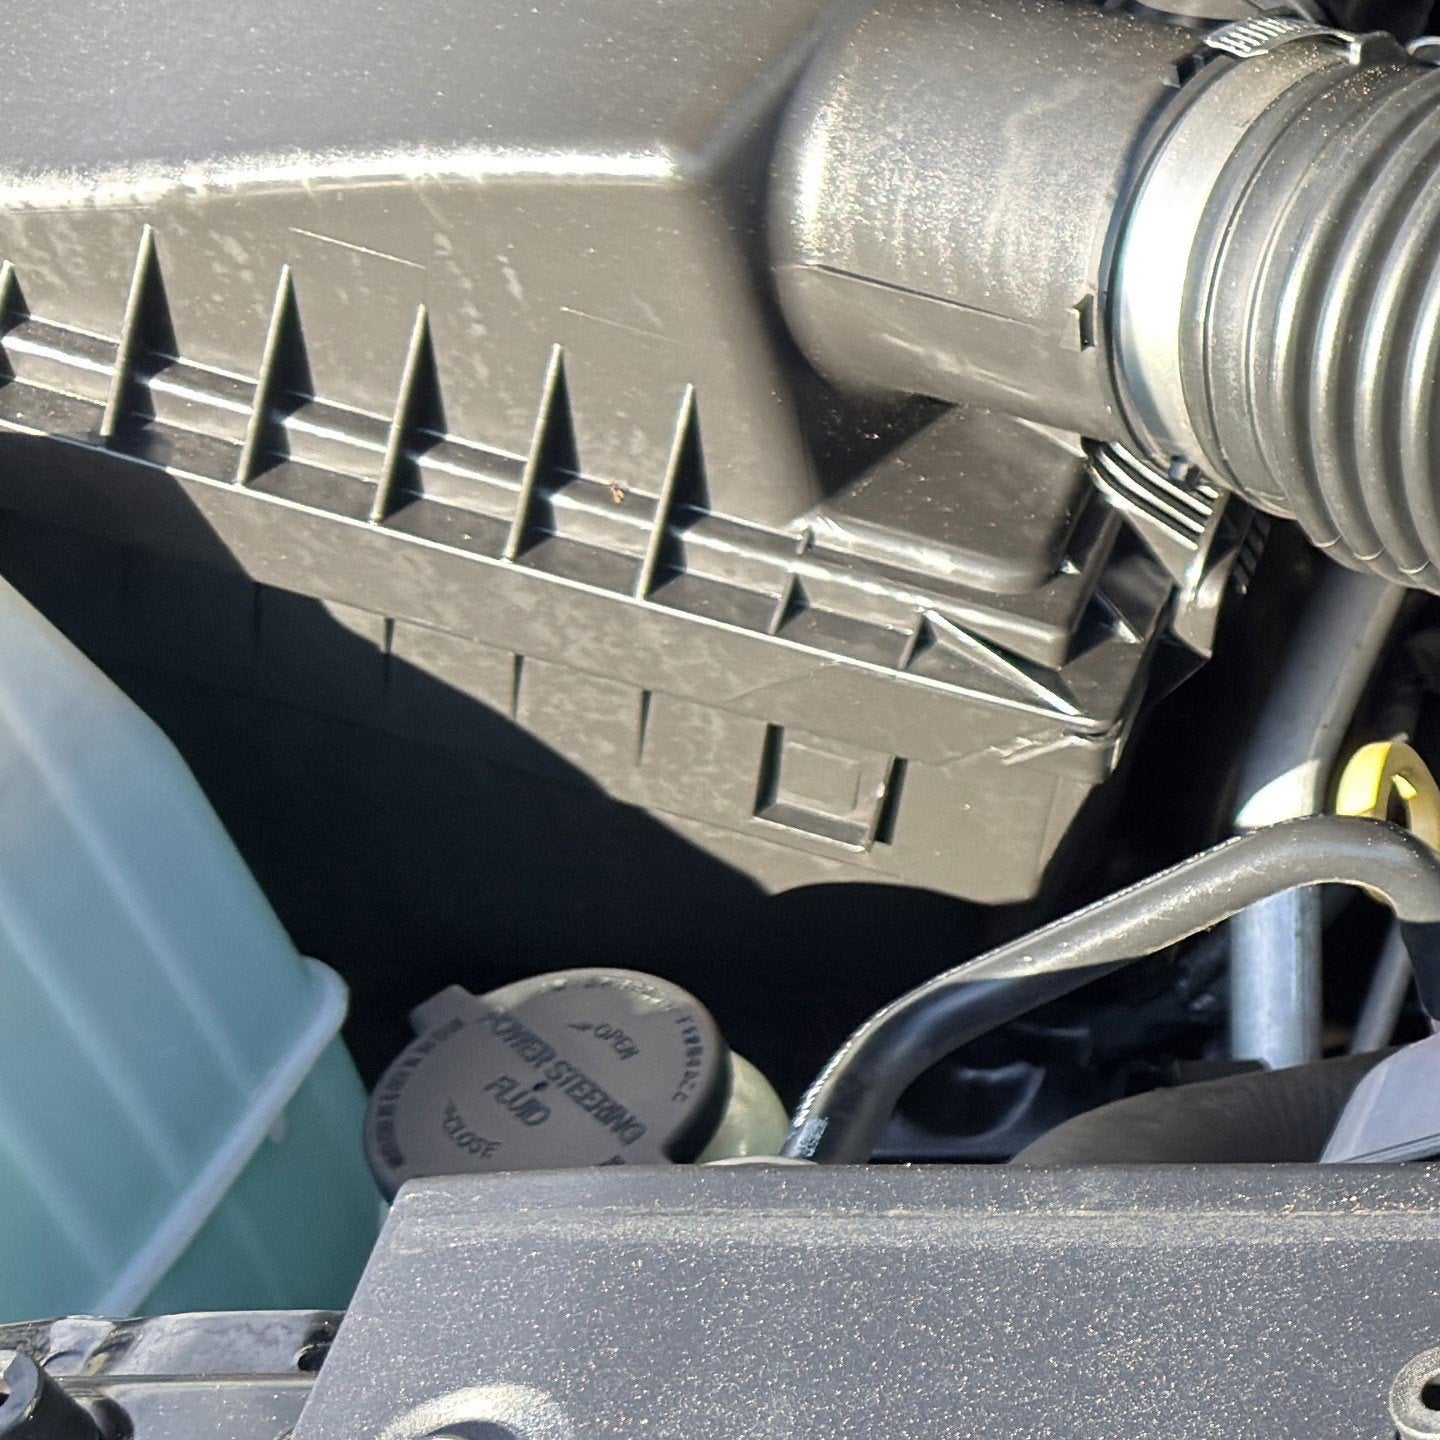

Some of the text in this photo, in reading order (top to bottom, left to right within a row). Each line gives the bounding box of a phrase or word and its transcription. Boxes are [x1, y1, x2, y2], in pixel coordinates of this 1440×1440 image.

[594, 1023, 640, 1061] OPEN
[477, 1010, 557, 1071] POWER
[545, 1059, 648, 1147] STEERING
[484, 1075, 551, 1127] FLUID
[442, 1107, 501, 1159] CLOSE
